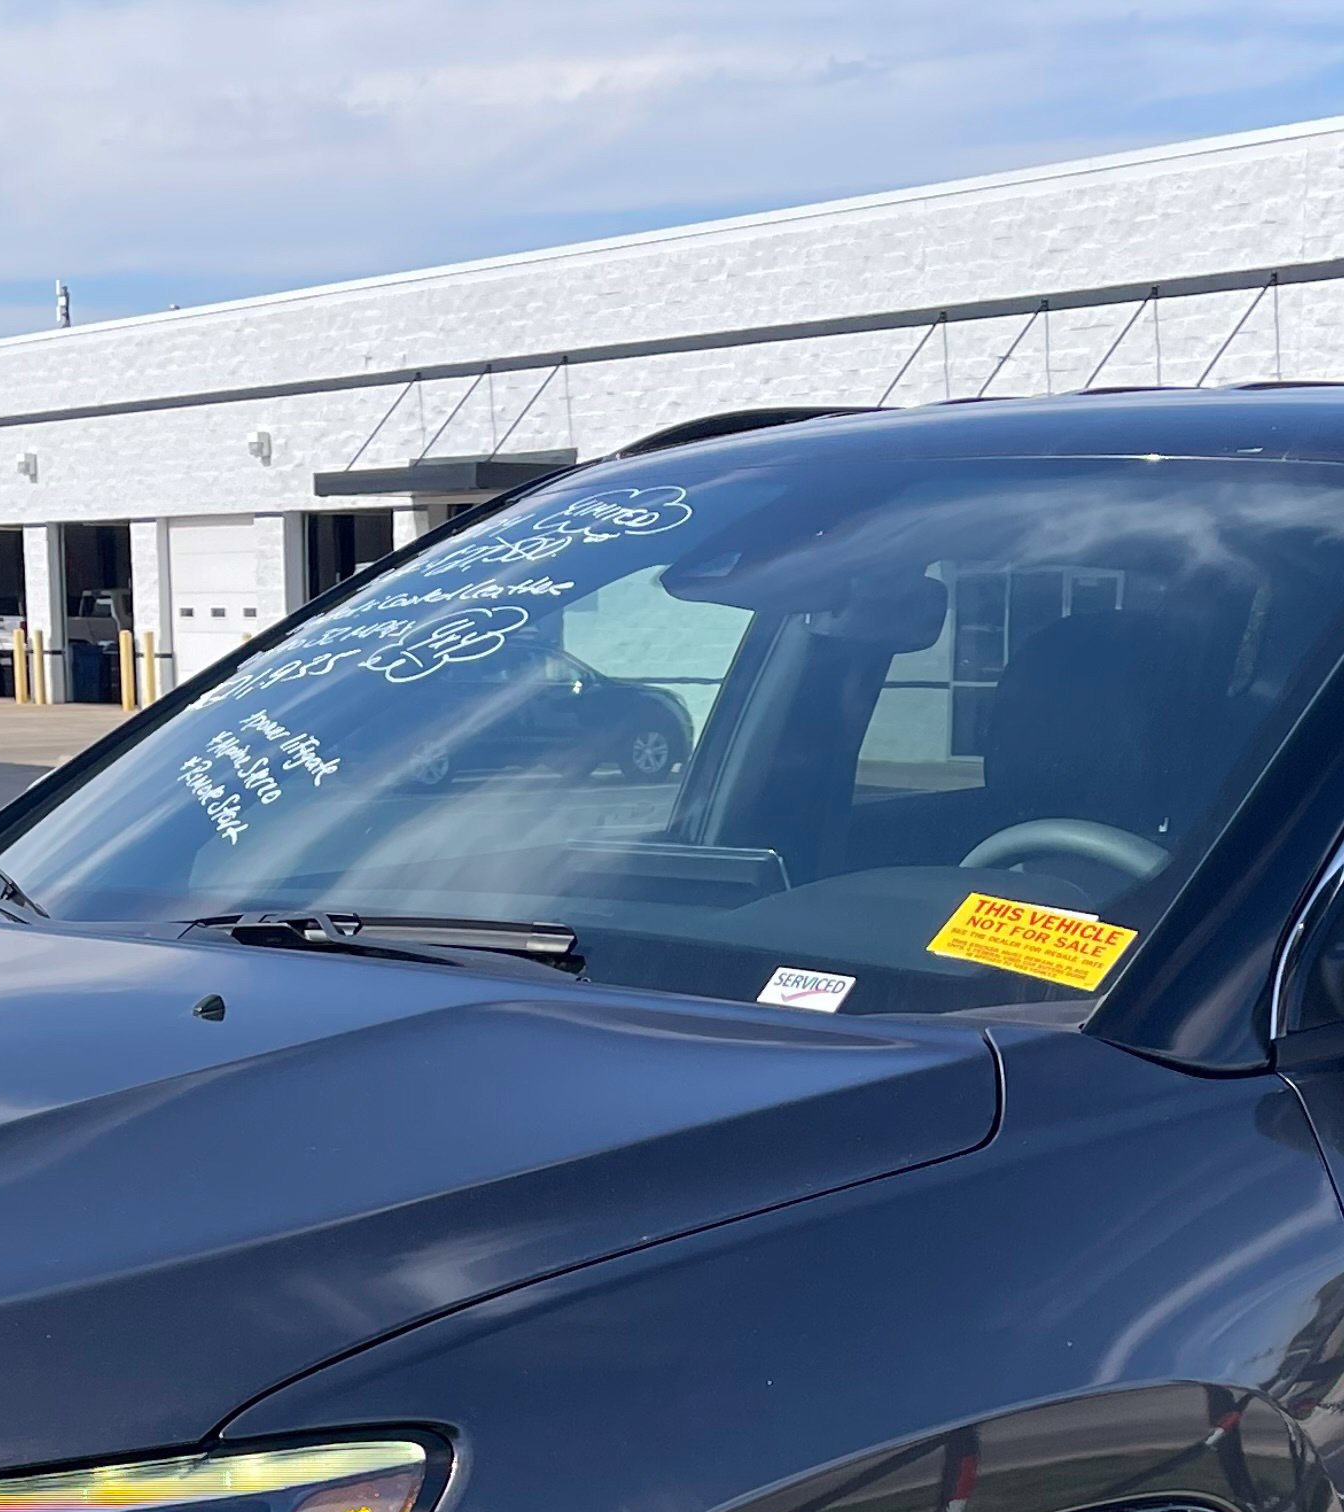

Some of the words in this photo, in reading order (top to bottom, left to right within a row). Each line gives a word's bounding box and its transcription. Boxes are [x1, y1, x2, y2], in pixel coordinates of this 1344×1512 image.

[207, 793, 249, 845] Start
[966, 915, 1007, 933] NOT
[1009, 925, 1051, 944] FOR
[1054, 936, 1106, 958] SALE
[974, 899, 1025, 922] THIS
[1029, 911, 1124, 946] VEHICLE
[951, 927, 966, 936] SEE
[969, 931, 986, 940] THE
[988, 934, 1022, 949] DEALER
[1024, 943, 1041, 952] FOR
[1081, 958, 1105, 969] DATE
[773, 972, 846, 994] SERVICED
